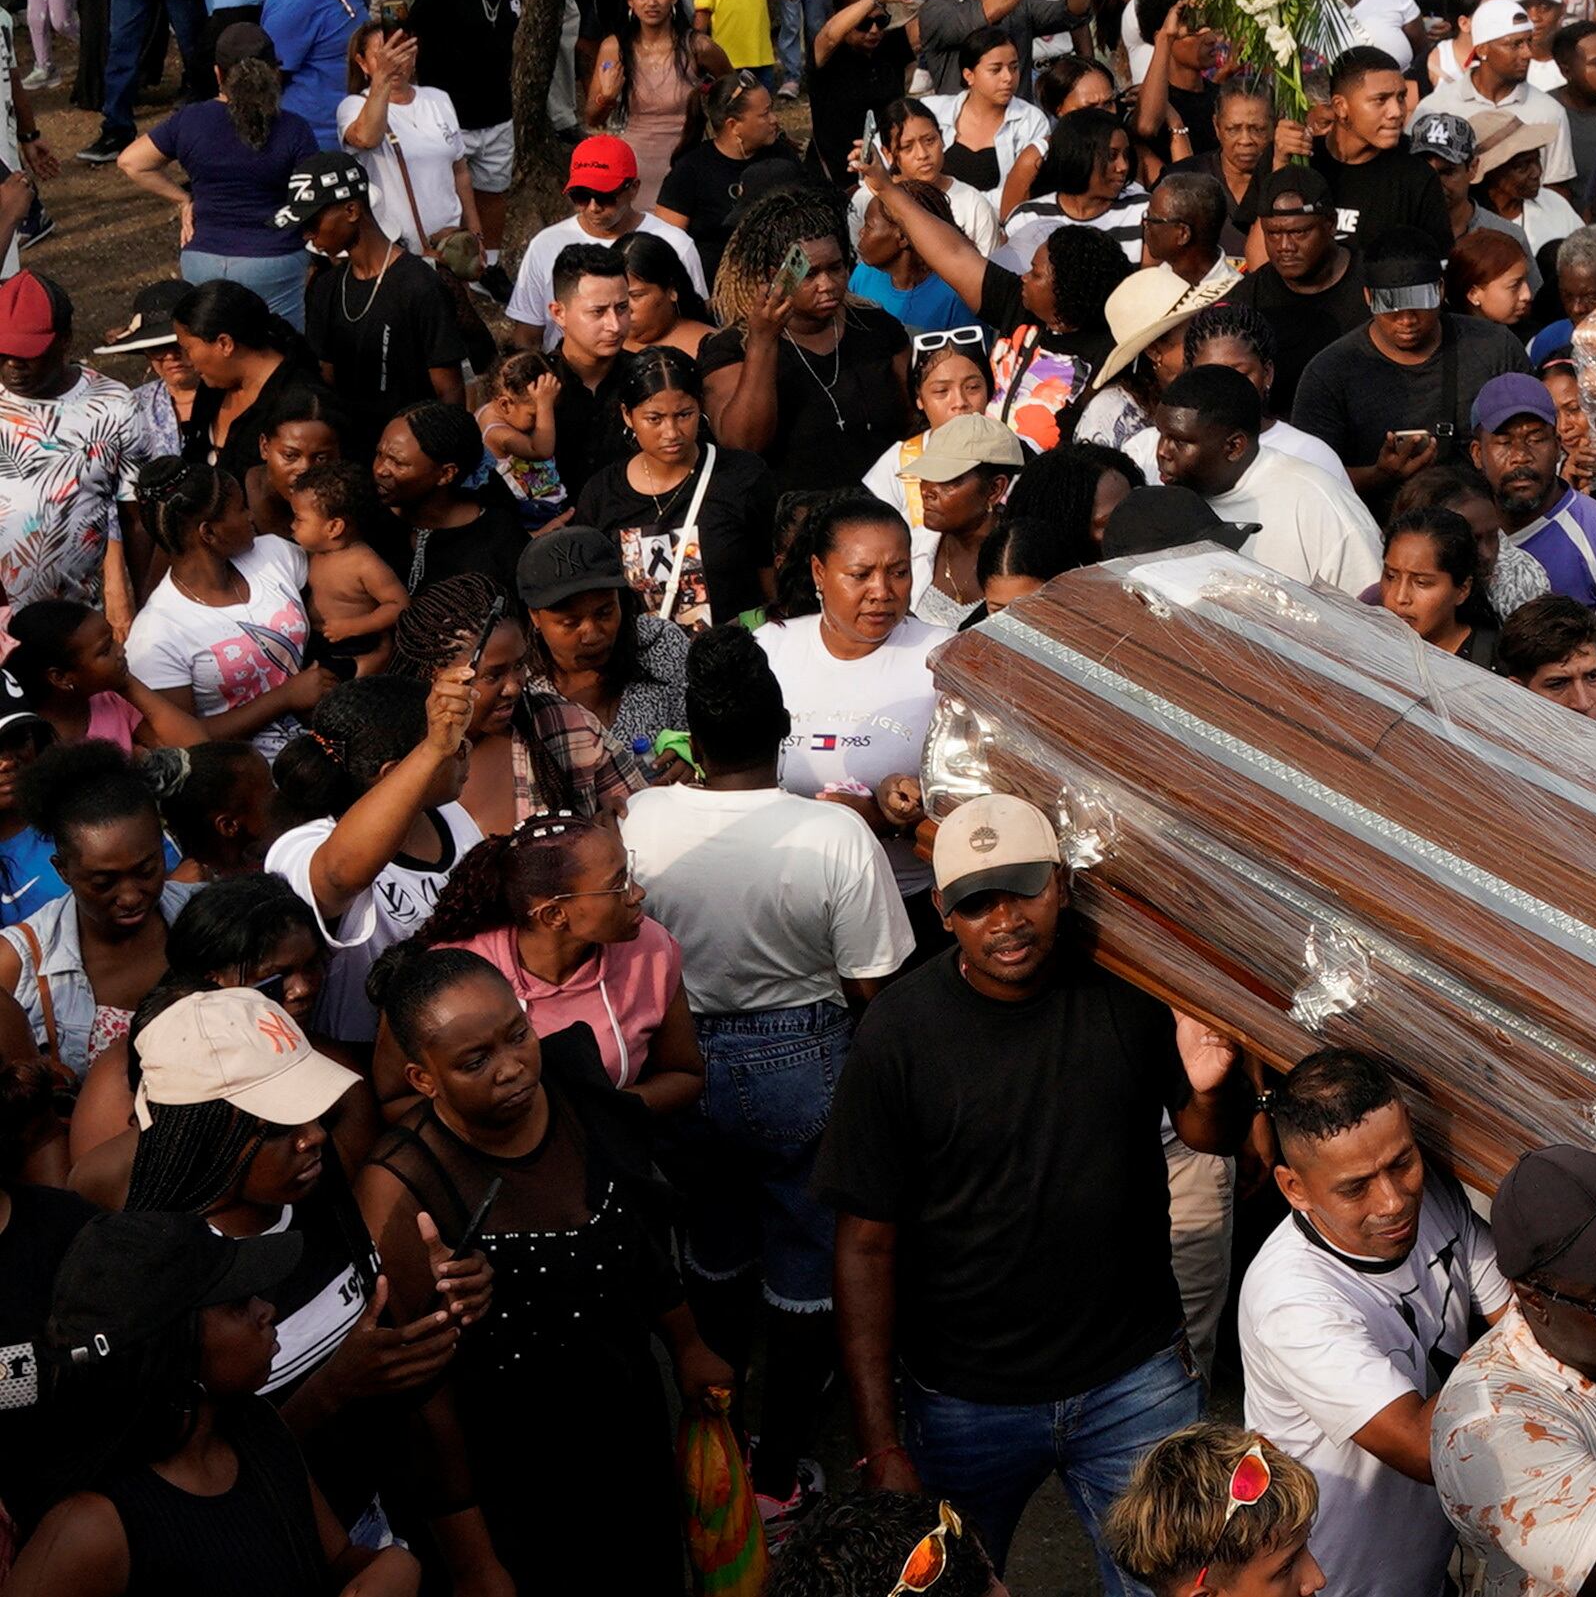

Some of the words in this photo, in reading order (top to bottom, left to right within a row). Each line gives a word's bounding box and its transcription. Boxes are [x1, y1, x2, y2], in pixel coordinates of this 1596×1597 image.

[1427, 119, 1448, 145] LA
[1333, 207, 1358, 233] KE
[840, 735, 872, 747] 1985
